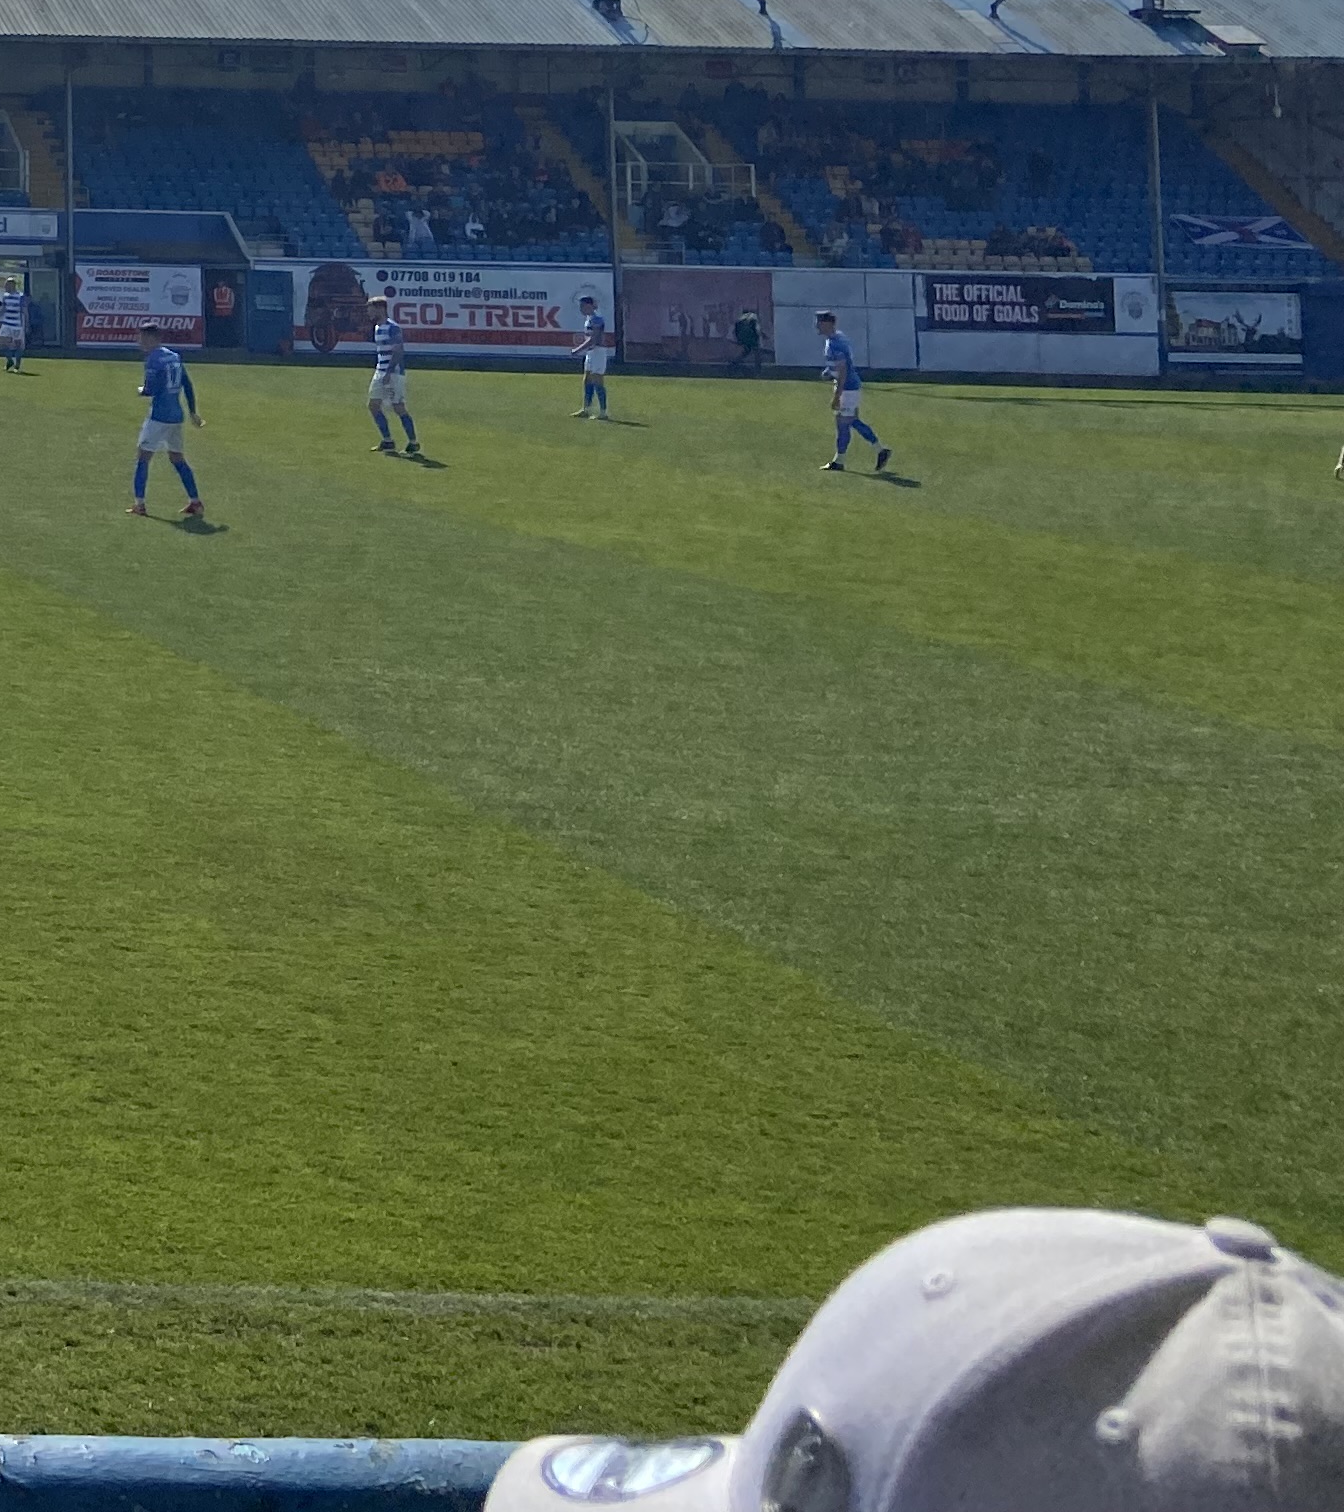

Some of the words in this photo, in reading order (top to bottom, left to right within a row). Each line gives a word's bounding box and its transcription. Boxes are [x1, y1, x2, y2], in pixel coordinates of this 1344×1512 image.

[933, 283, 960, 301] THE
[963, 285, 1025, 303] OFFICIAL
[81, 316, 196, 330] DELLINGBURN
[392, 302, 562, 329] GO-TREK
[933, 304, 969, 322] FOOD
[972, 305, 991, 322] OF
[993, 306, 1039, 324] GOALS
